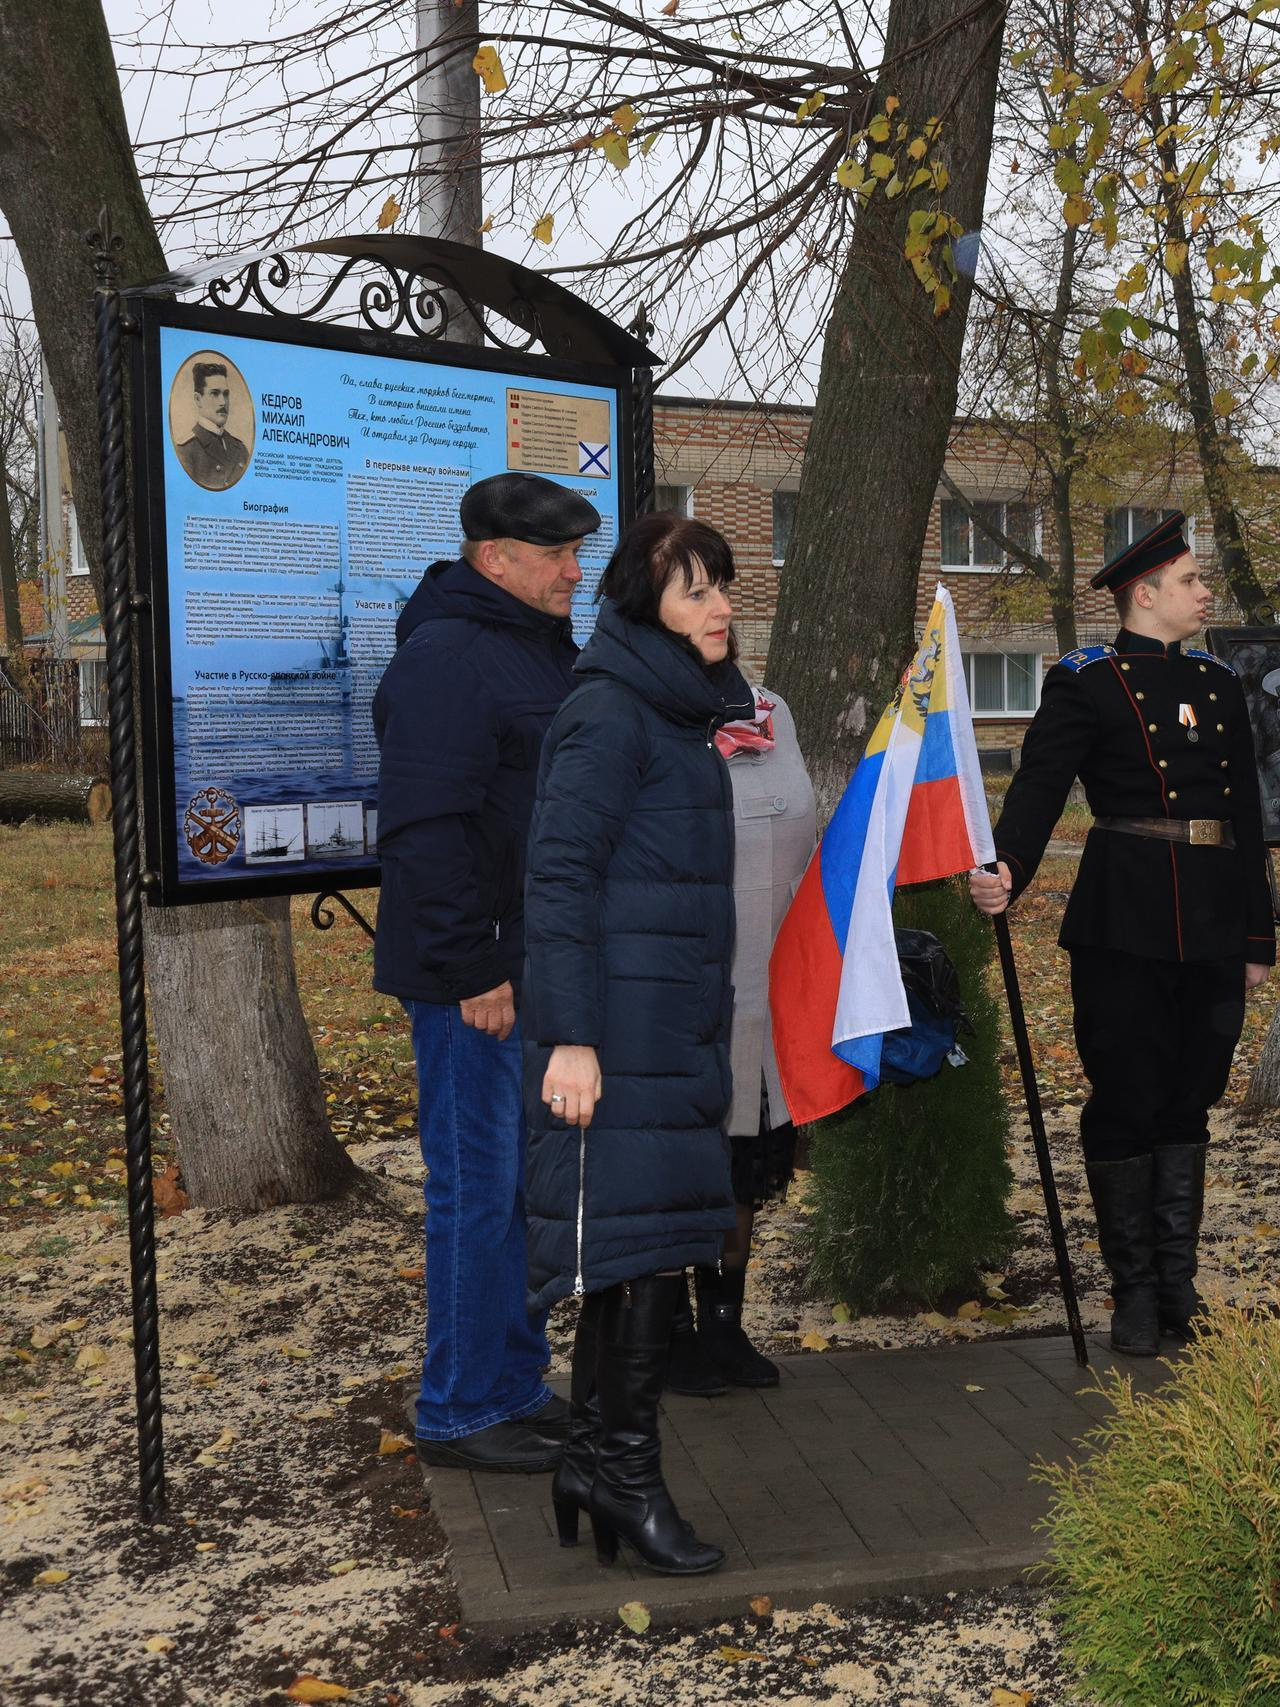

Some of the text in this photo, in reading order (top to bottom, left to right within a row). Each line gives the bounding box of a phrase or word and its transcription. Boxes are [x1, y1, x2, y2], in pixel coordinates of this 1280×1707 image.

[340, 373, 495, 404] Да, слава русских моряков бессмертна,
[261, 393, 302, 411] КЕДРОВ
[367, 393, 471, 416] В историю вписали имена
[262, 410, 304, 427] МИХАИЛ
[348, 407, 489, 436] Тех, кто любил Россию беззаветно,
[262, 428, 350, 449] АЛЕКСАНДРОВИЧ
[360, 426, 479, 450] И отдавал за Родину сердца.
[365, 459, 469, 477] В перерыве между войнами
[243, 501, 288, 515] Биография
[355, 599, 385, 609] Участие
[195, 670, 228, 680] Участие
[239, 670, 308, 681] Русско-японской
[311, 671, 335, 679] войне
